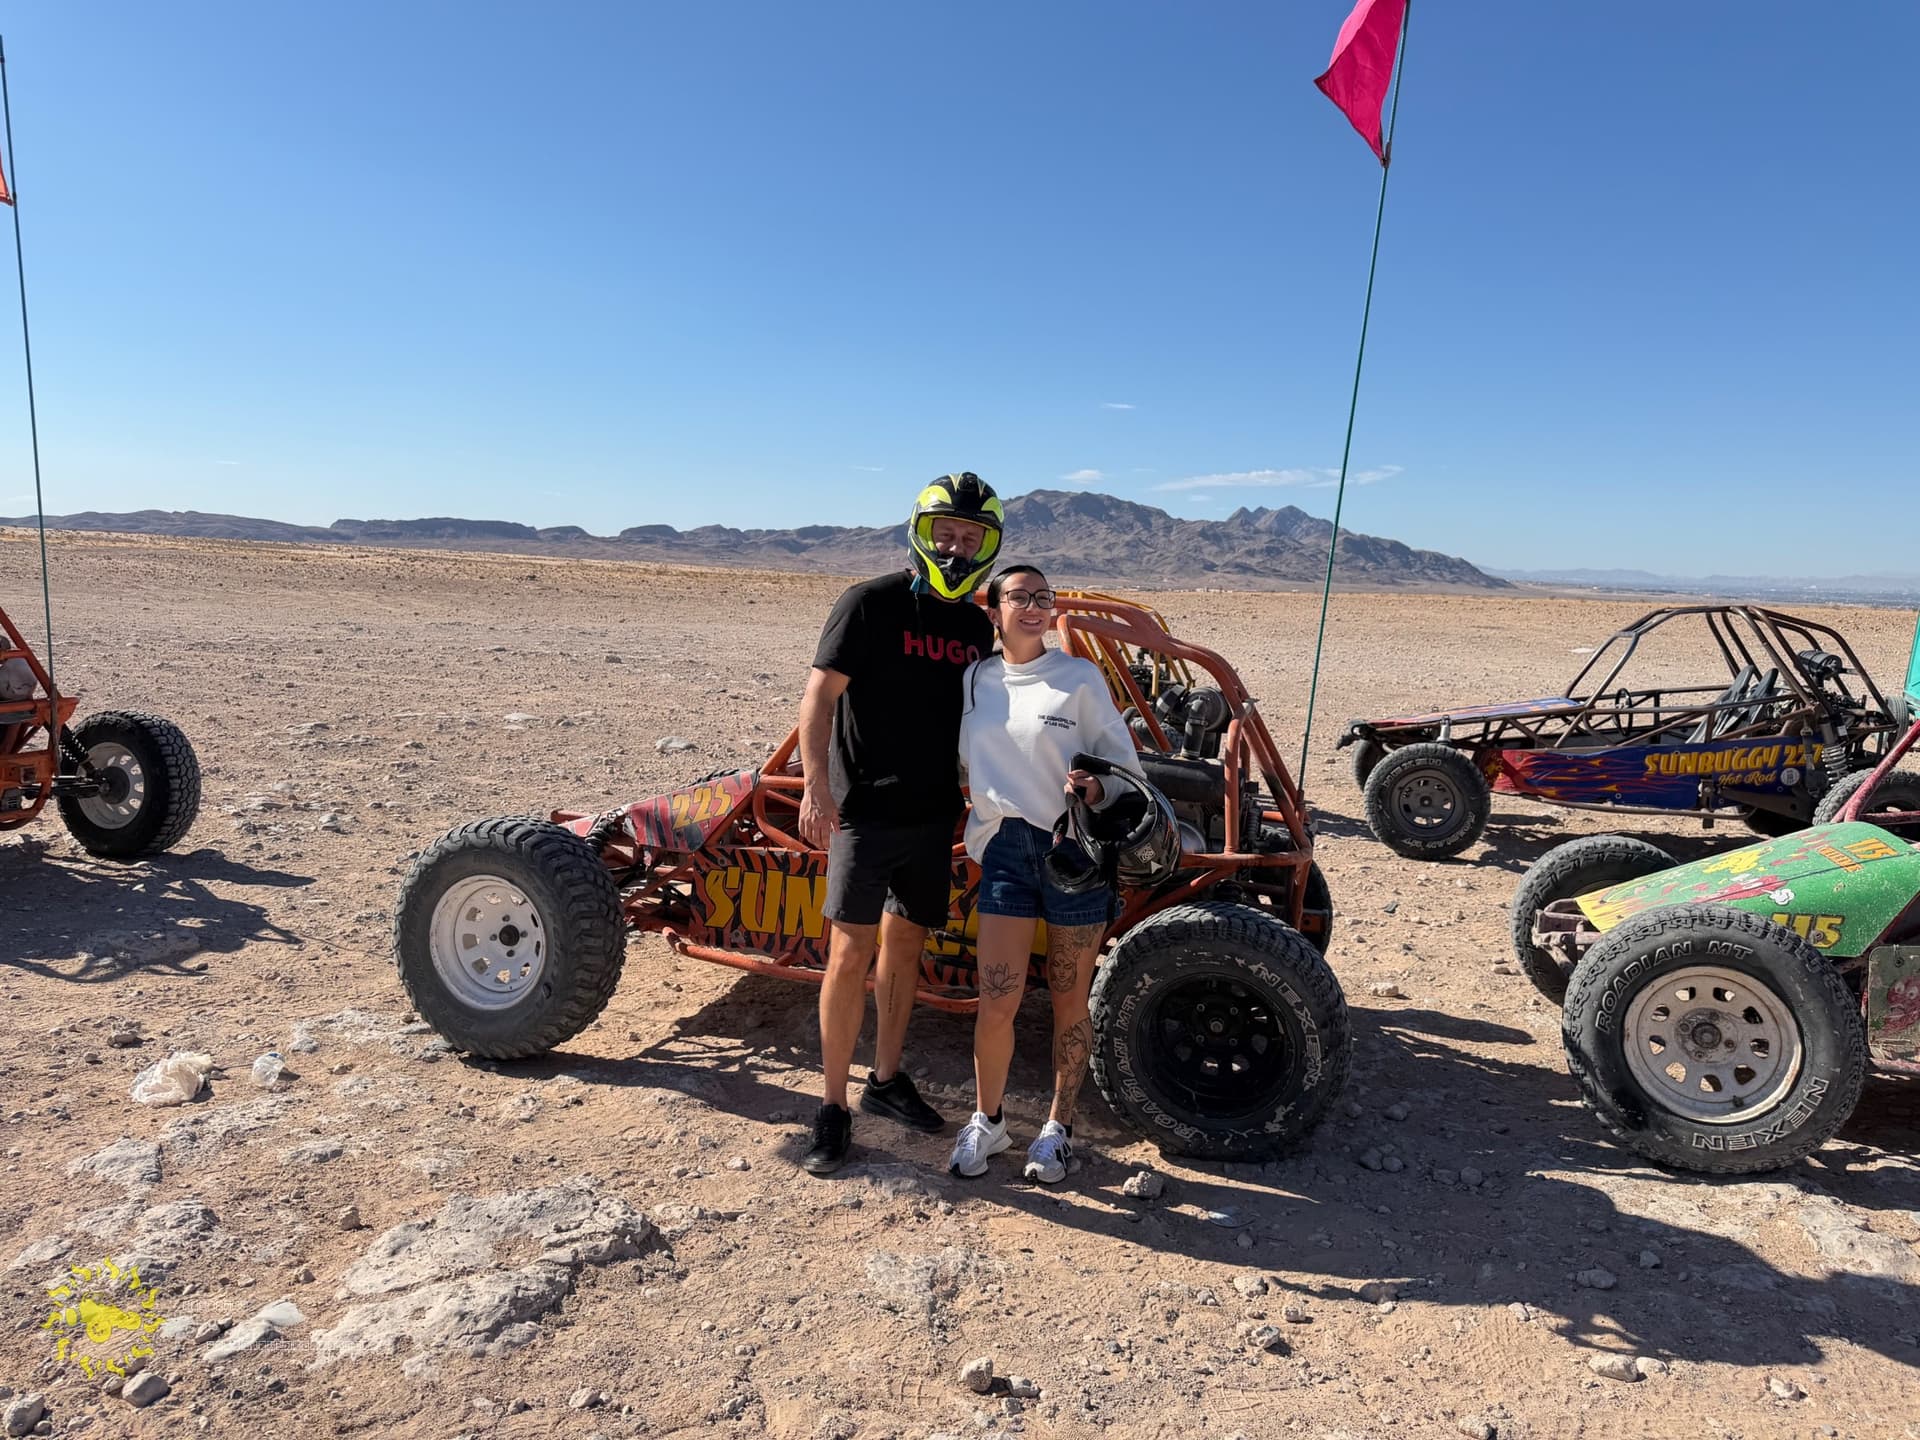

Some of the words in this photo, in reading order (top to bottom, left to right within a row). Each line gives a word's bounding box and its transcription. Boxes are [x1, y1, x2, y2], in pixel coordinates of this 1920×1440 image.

[904, 630, 980, 664] HUGO
[1644, 744, 1780, 775] SUNBUGGY
[1718, 774, 1742, 786] Hot
[1743, 770, 1777, 786] Rod
[672, 783, 732, 831] 225
[1842, 837, 1899, 860] 115
[1594, 940, 1693, 1034] ROADIAN
[1705, 940, 1754, 960] MT
[1115, 994, 1136, 1032] MT
[1249, 962, 1323, 1090] NEXEN
[1114, 1037, 1199, 1141] ROADIAN
[1692, 1076, 1830, 1152] NEXEN
